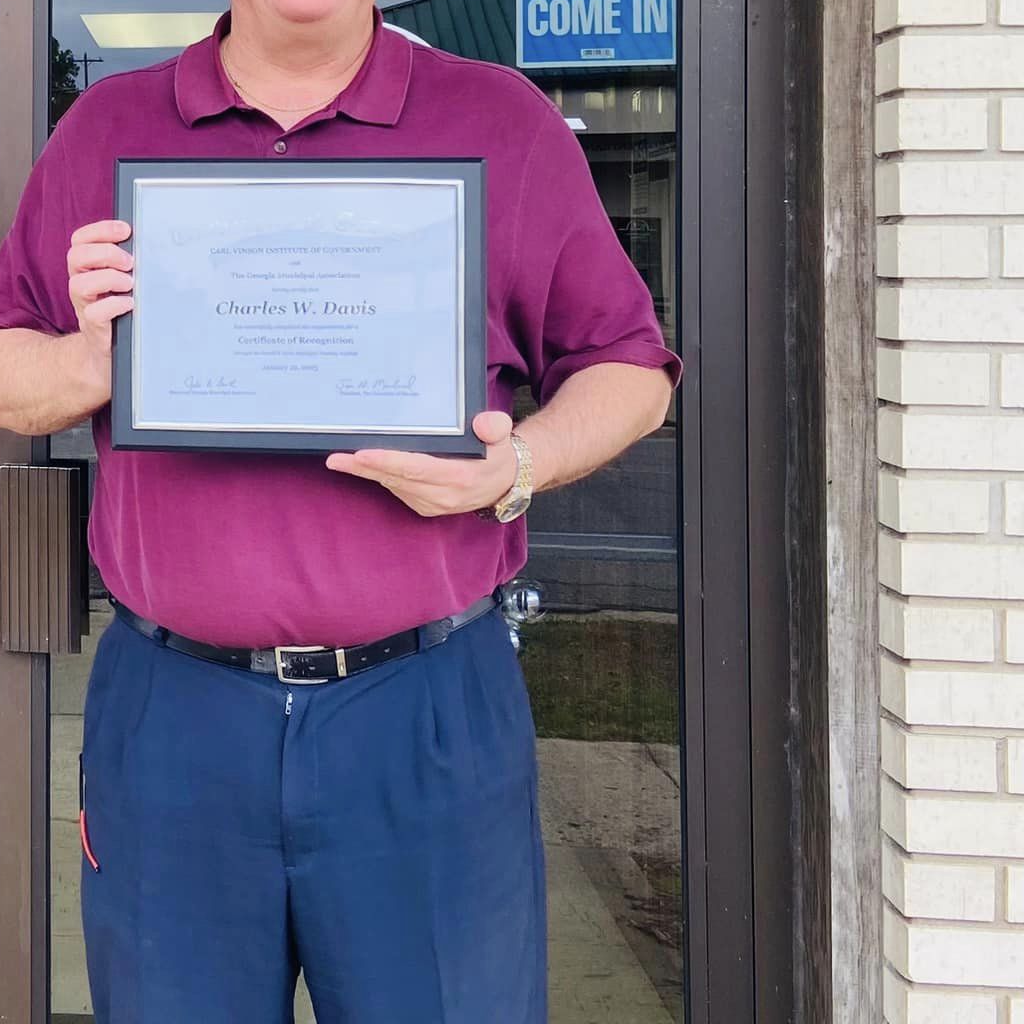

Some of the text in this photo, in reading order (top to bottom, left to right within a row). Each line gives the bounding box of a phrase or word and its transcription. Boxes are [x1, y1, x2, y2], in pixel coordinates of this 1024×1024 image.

[216, 299, 377, 316] Charles W. Davis
[237, 336, 354, 346] Certificate of Recognition
